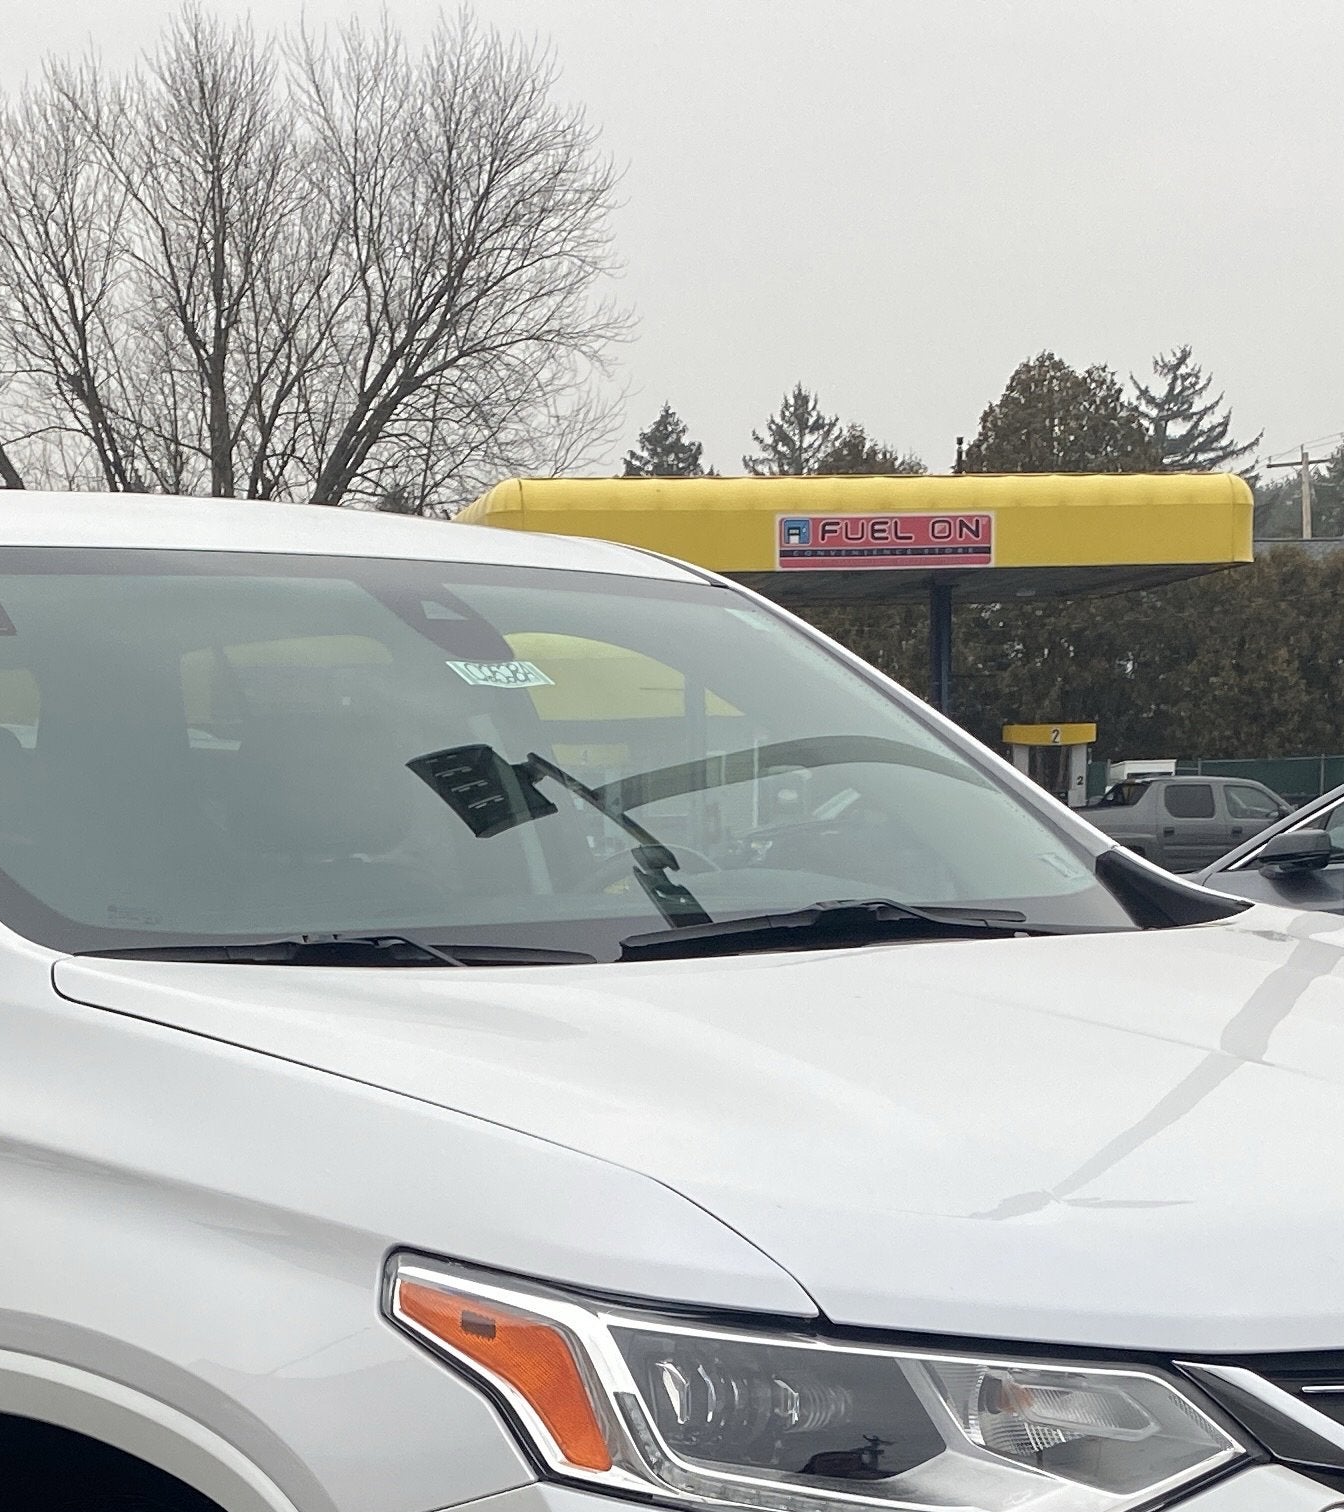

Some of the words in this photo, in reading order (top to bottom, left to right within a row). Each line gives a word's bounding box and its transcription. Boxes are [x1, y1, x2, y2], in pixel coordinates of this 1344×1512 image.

[819, 518, 914, 542] FUEL
[930, 518, 981, 541] ON
[1052, 729, 1060, 743] 2
[1077, 776, 1084, 785] 2
